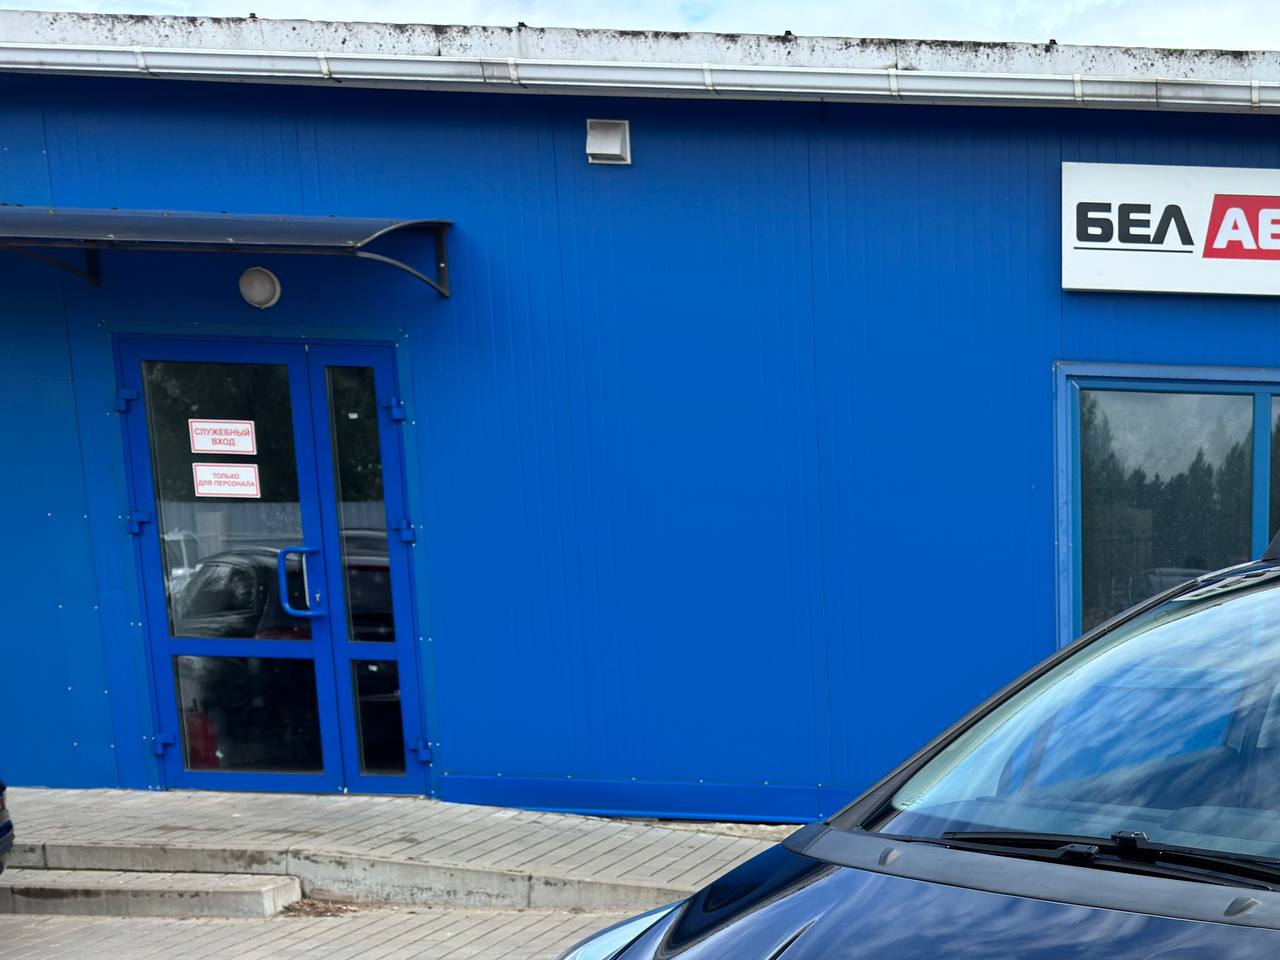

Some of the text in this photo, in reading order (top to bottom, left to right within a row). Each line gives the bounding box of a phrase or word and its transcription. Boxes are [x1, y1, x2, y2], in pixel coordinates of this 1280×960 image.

[1076, 201, 1194, 246] БЕЛ
[194, 427, 250, 437] СЛУЖЕБНЫЙ
[211, 438, 236, 447] ВХОД
[212, 472, 240, 480] ТОЛЬКО
[213, 480, 255, 488] ПЕРСОНАЛА
